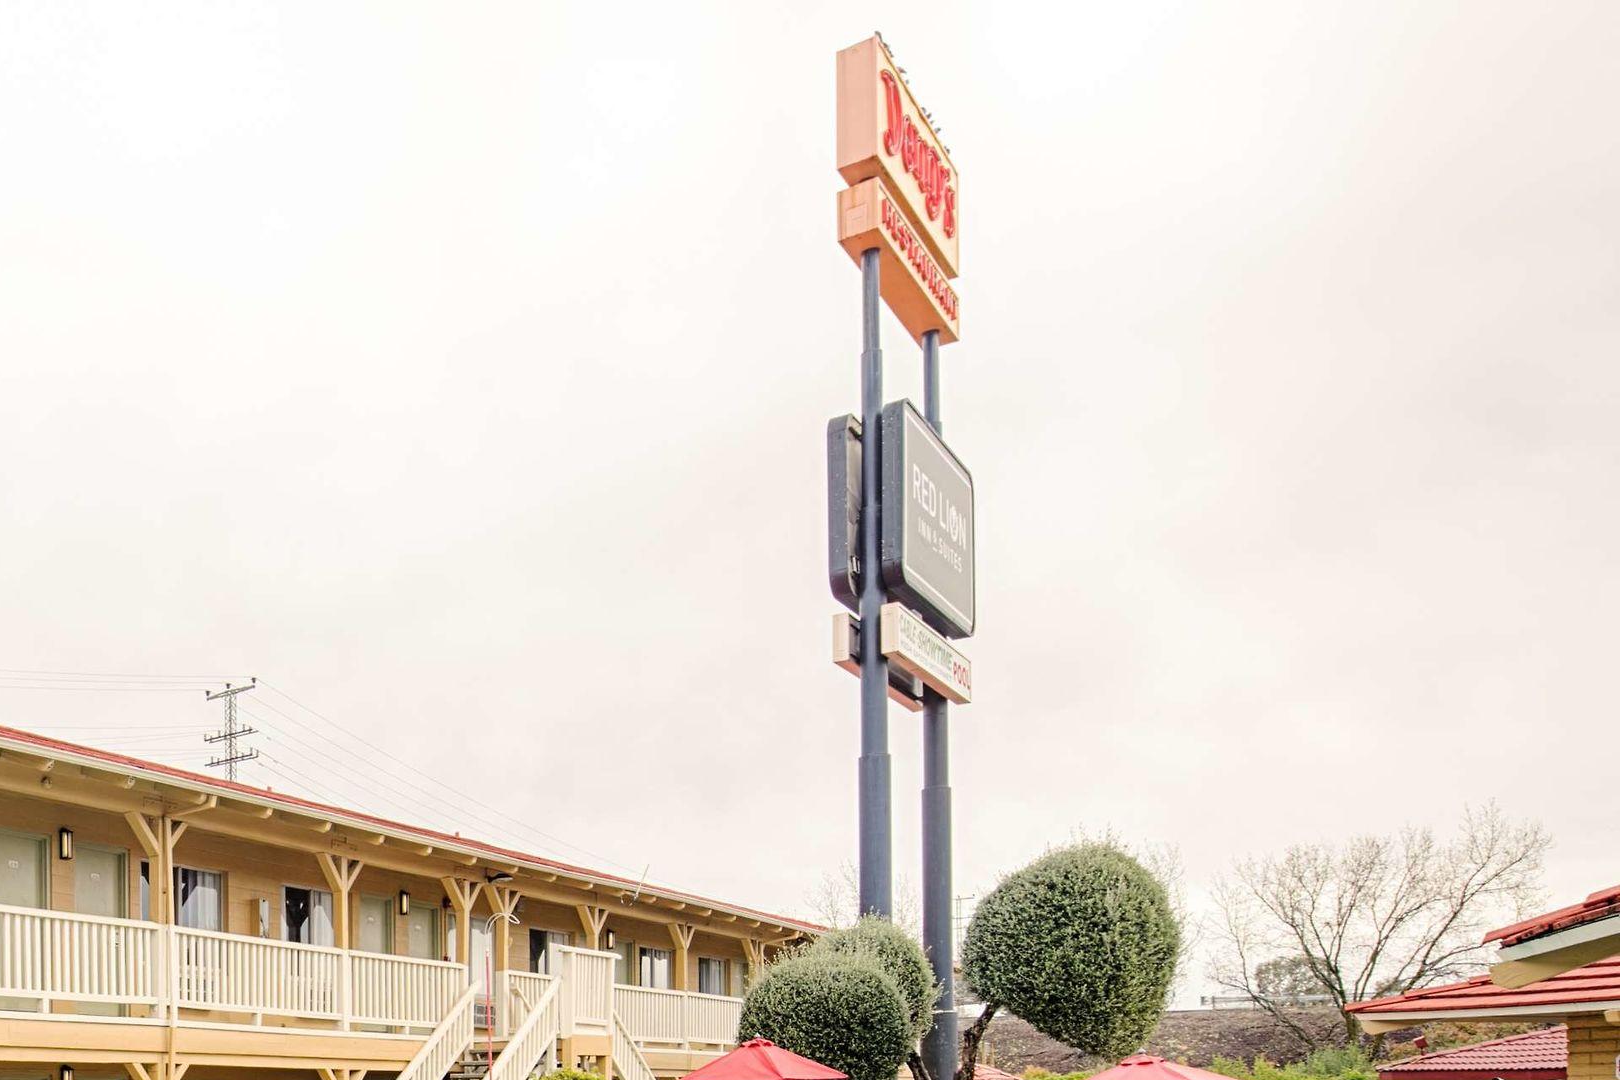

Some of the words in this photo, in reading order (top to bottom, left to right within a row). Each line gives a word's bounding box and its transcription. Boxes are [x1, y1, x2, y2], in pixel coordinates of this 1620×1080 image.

[880, 69, 955, 238] Denny's
[912, 463, 937, 519] RED
[939, 492, 966, 550] LION
[918, 516, 931, 546] INN
[938, 540, 963, 573] SUITES
